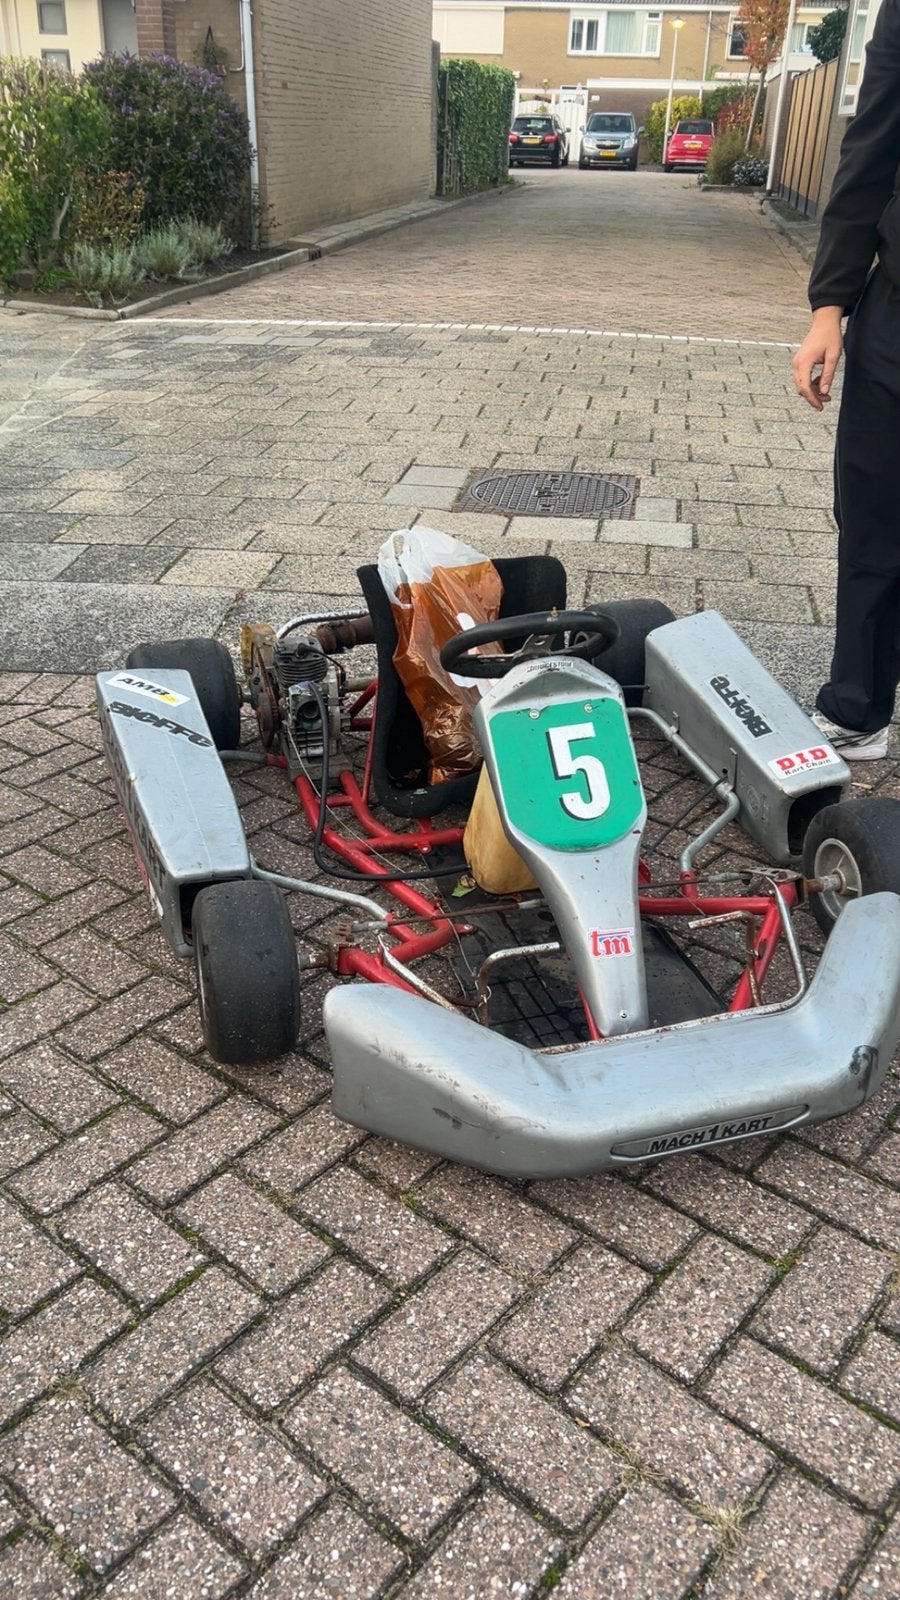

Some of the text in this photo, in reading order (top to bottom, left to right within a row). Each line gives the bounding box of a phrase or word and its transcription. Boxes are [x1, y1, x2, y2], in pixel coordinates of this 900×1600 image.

[116, 677, 170, 696] AMB
[546, 722, 611, 820] 5
[784, 758, 832, 776] Kart Chain
[650, 1116, 774, 1153] MACH 1 KART
